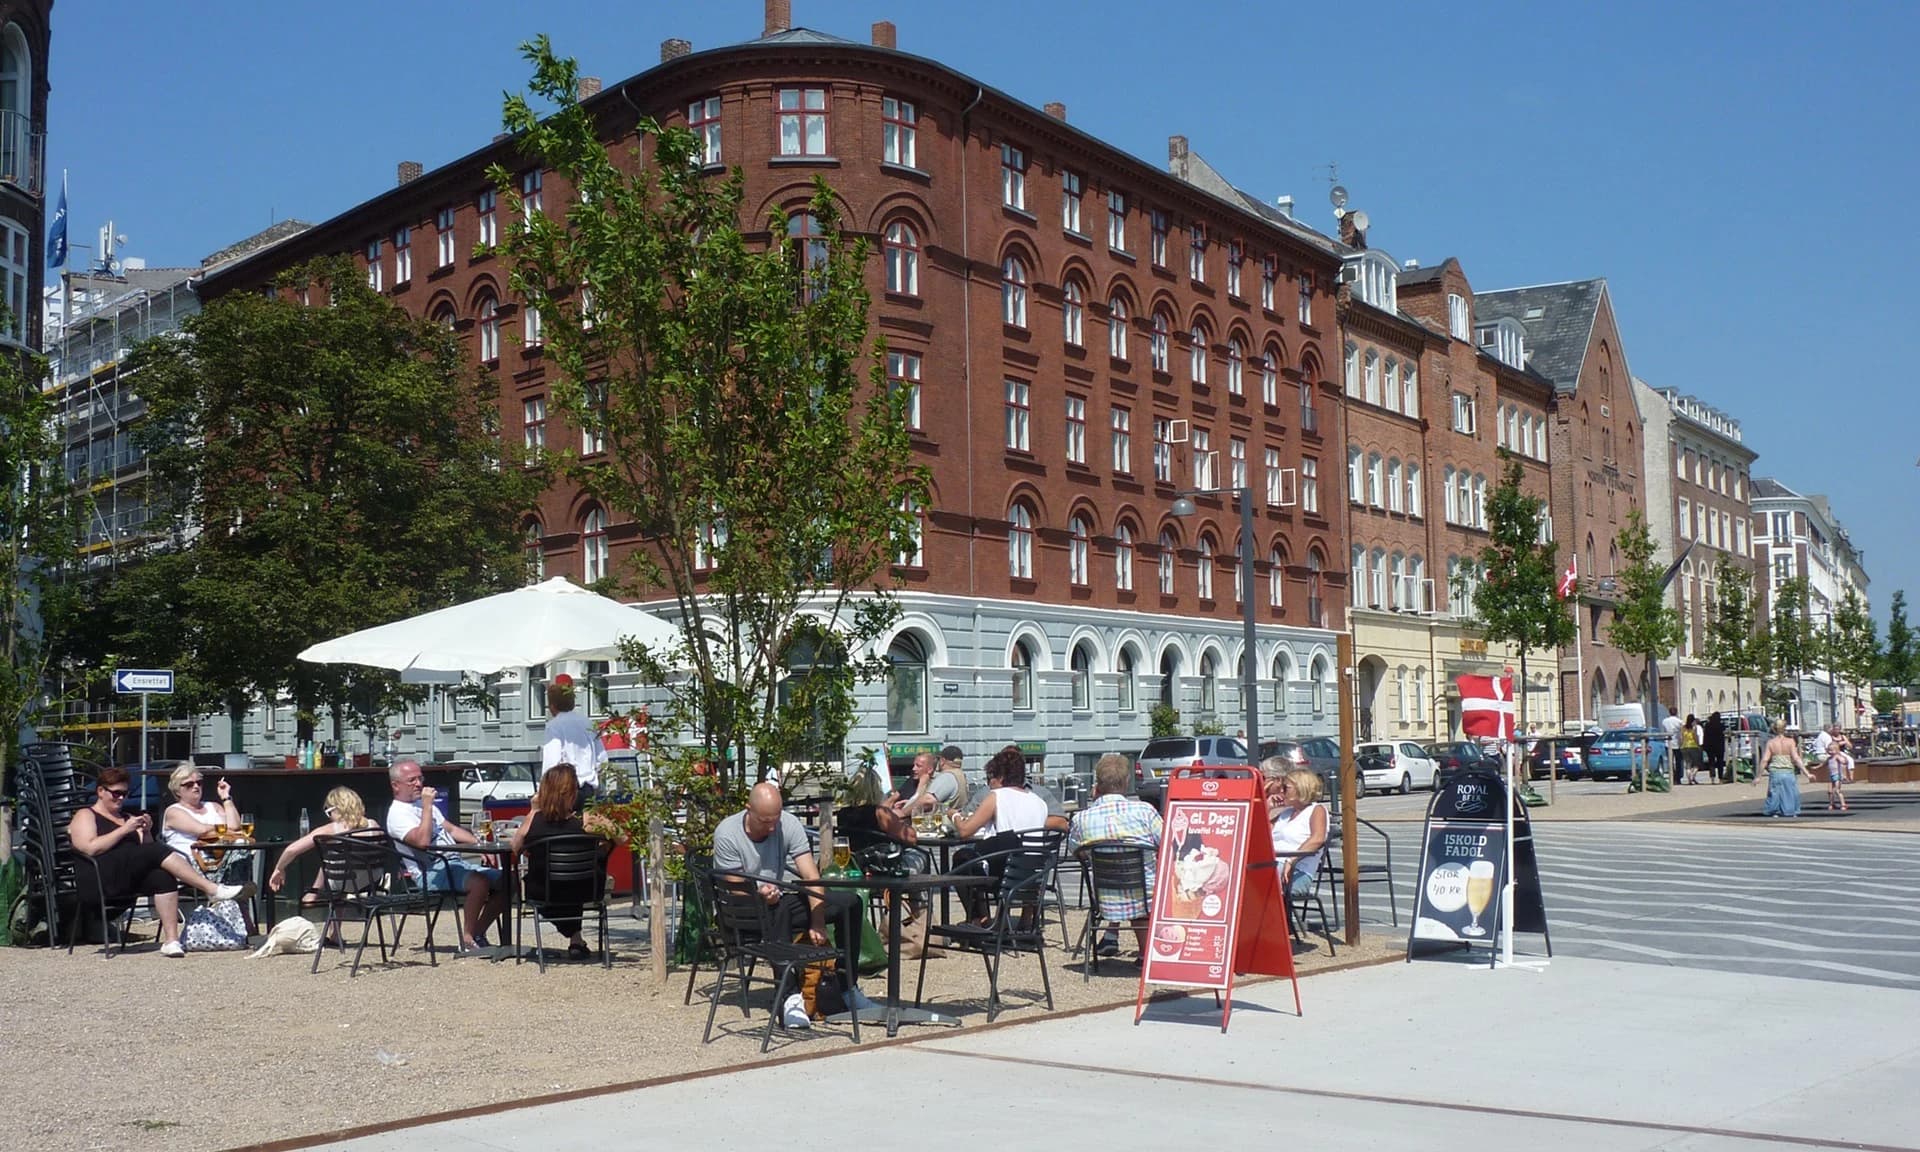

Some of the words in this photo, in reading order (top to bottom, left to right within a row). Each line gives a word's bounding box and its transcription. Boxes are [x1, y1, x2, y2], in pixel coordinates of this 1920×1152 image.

[1457, 784, 1488, 795] ROYAL
[1208, 812, 1235, 828] Dags
[1444, 834, 1487, 846] ISKOLD
